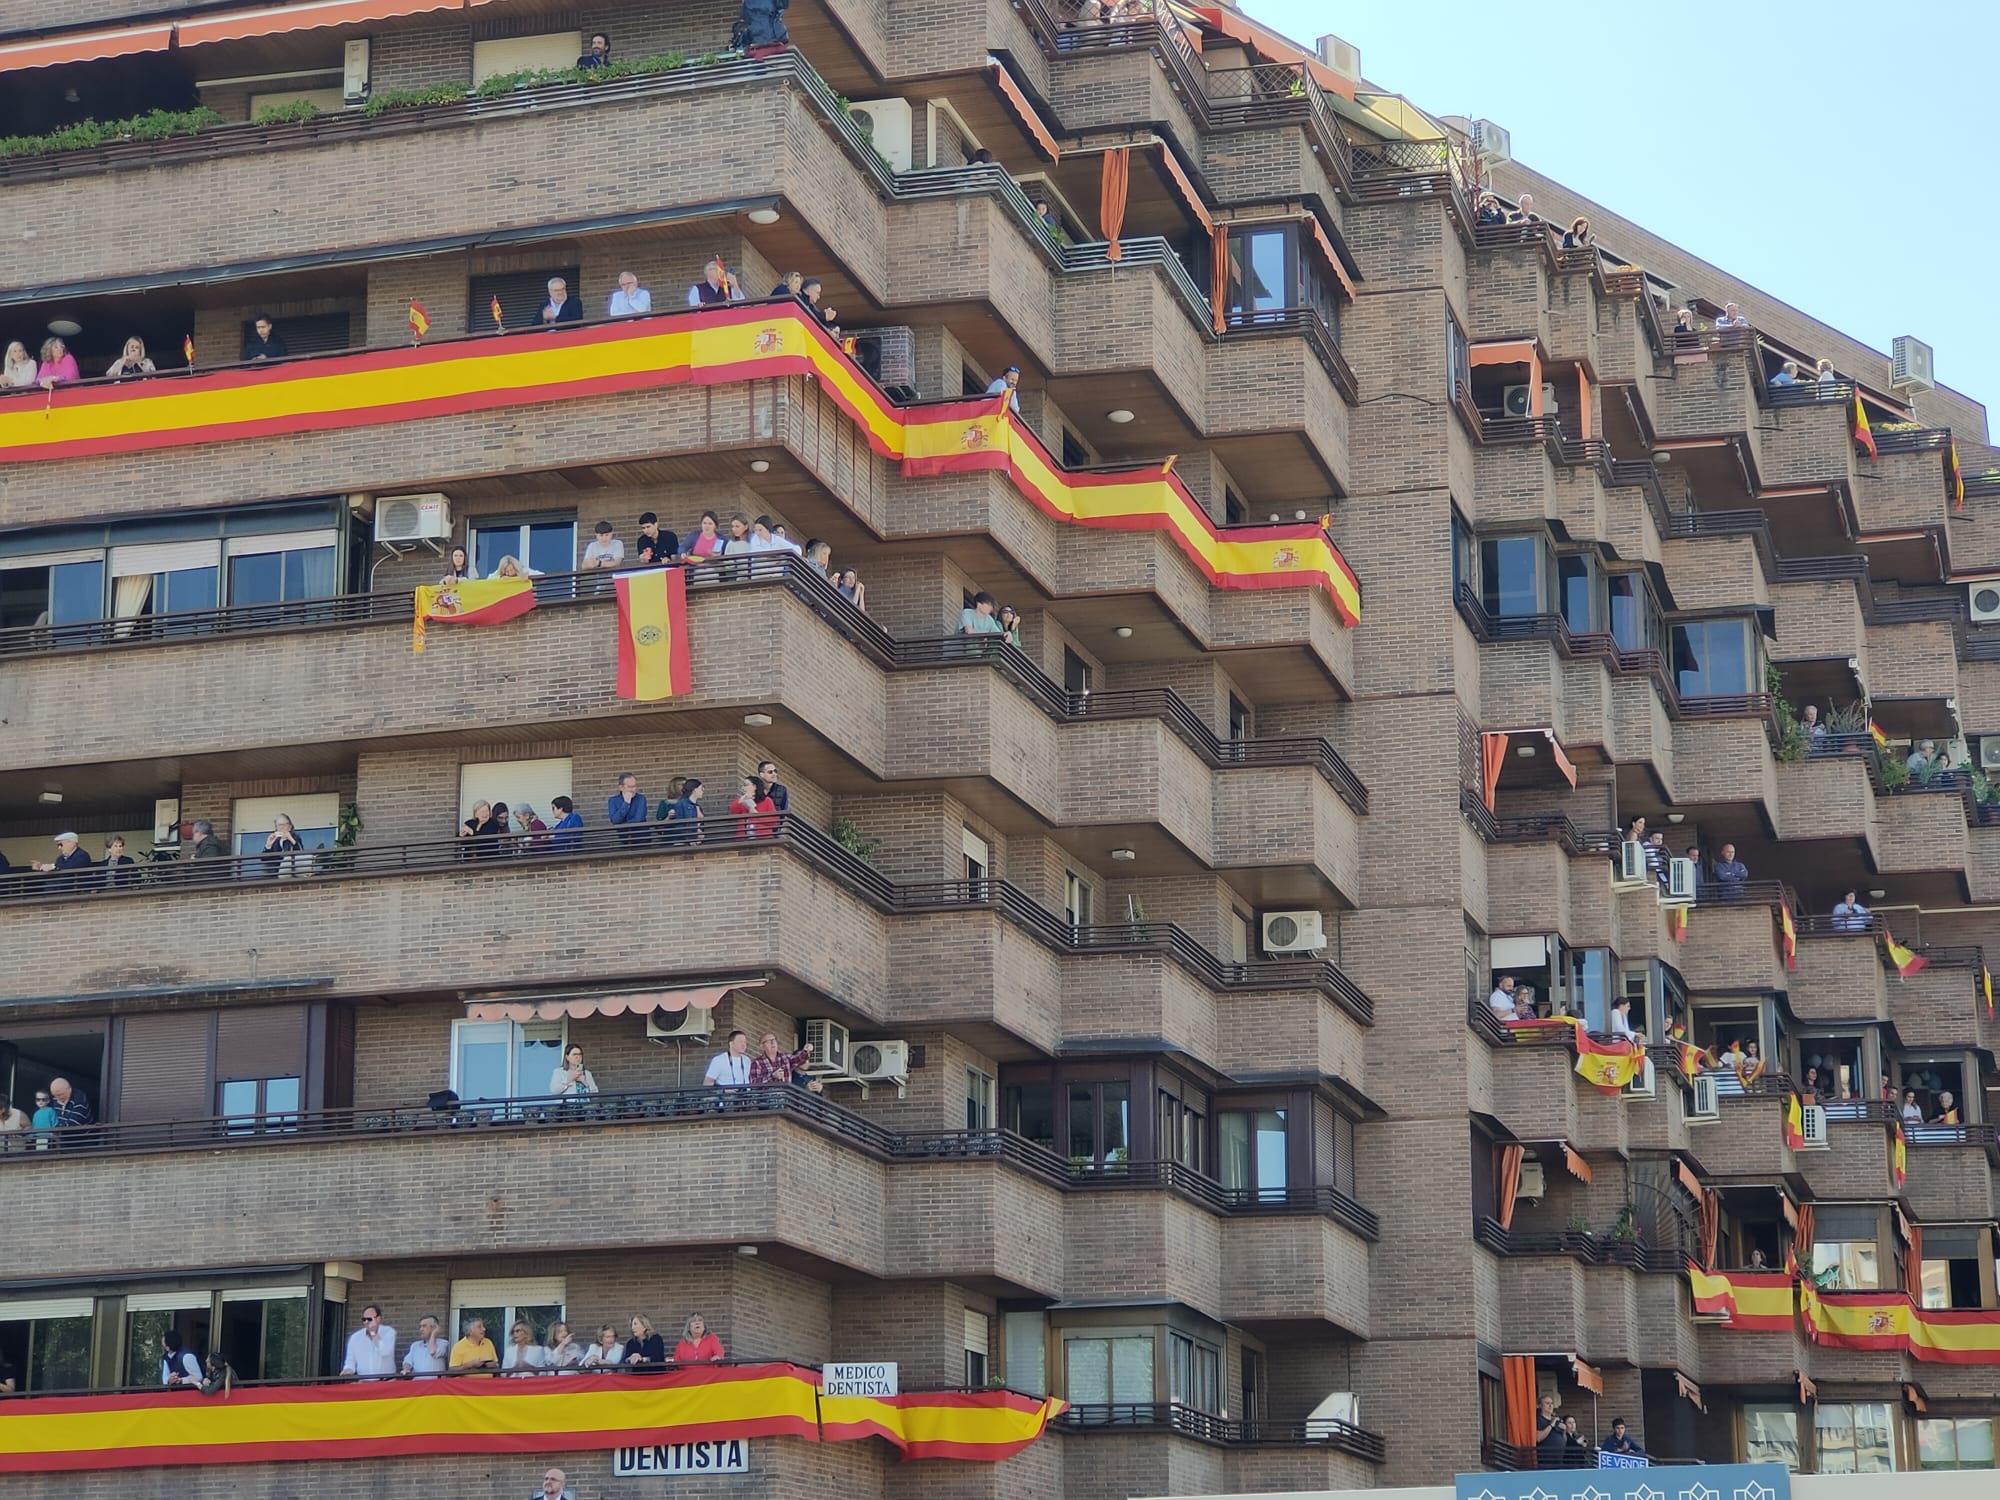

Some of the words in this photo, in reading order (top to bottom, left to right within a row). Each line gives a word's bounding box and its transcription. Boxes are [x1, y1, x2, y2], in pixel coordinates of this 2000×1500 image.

[834, 1366, 886, 1380] MEDICO
[828, 1381, 891, 1395] DENTISTA
[620, 1440, 742, 1471] DENTISTA
[1601, 1454, 1612, 1467] SE
[1613, 1456, 1645, 1469] VENDE
